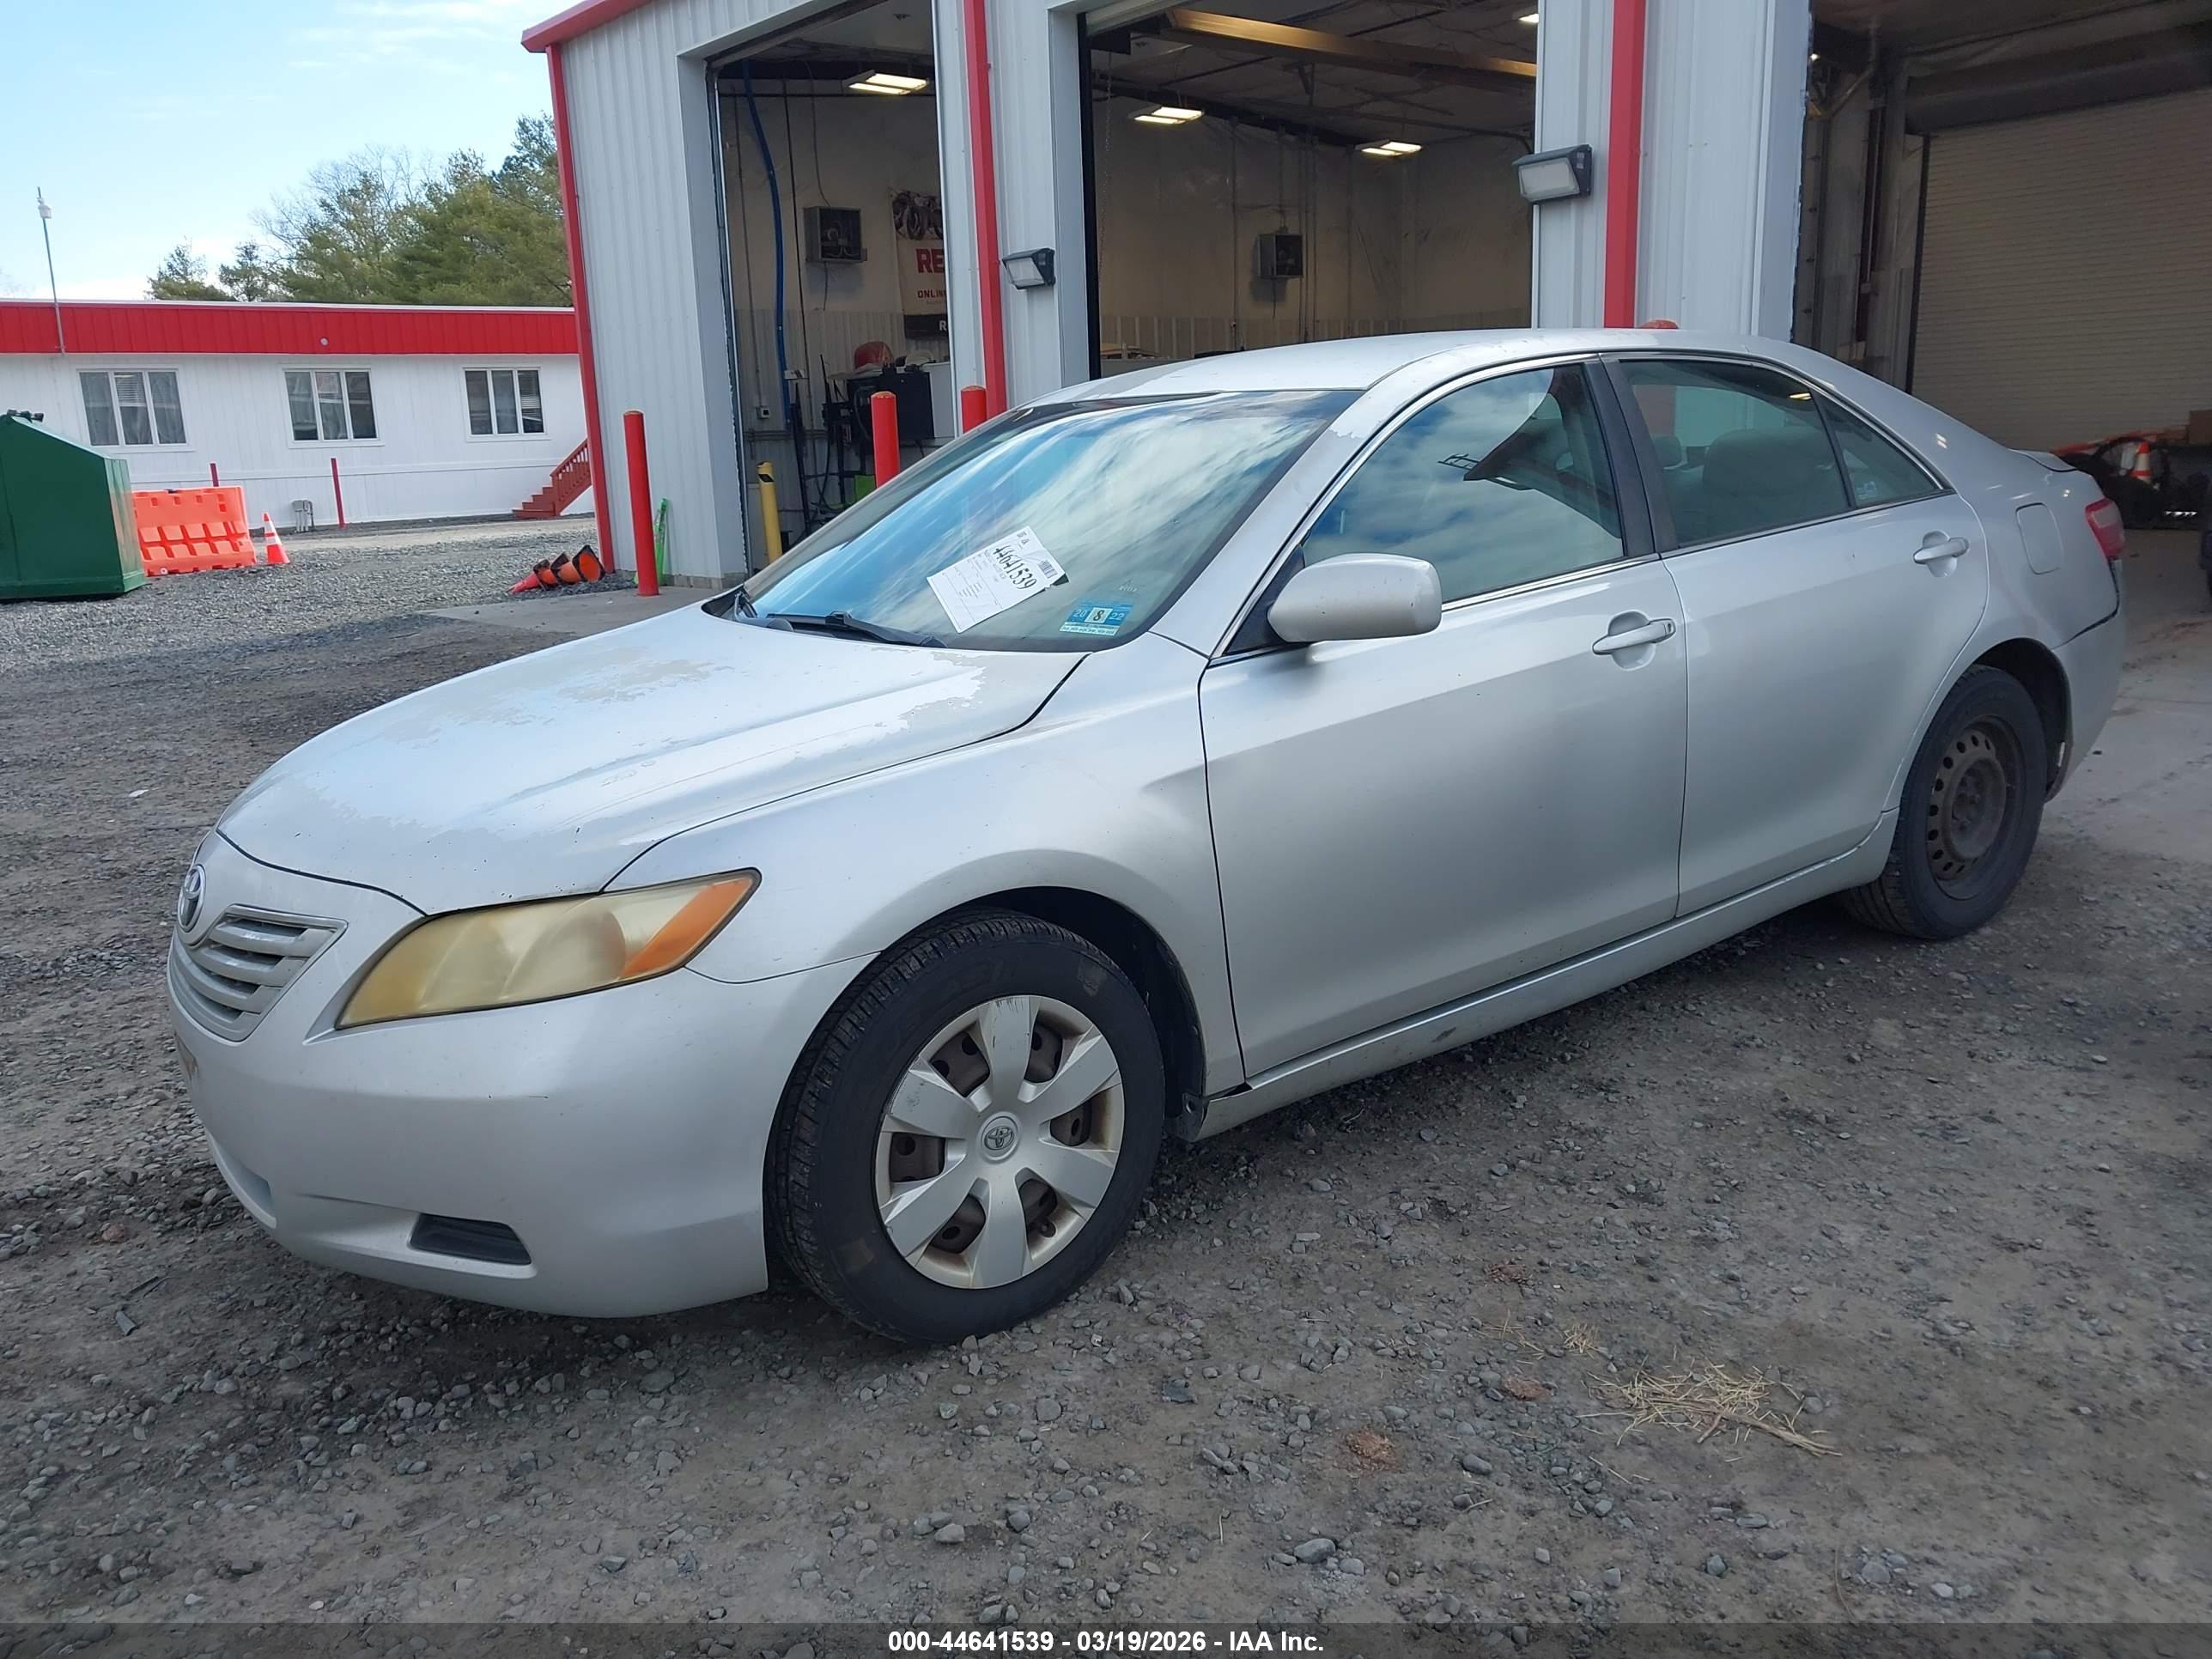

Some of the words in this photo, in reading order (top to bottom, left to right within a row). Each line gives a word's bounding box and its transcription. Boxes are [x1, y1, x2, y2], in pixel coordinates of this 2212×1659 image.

[993, 544, 1037, 590] 44641539
[1073, 609, 1088, 618] 20
[1092, 610, 1105, 622] 8
[1109, 611, 1125, 621] 22
